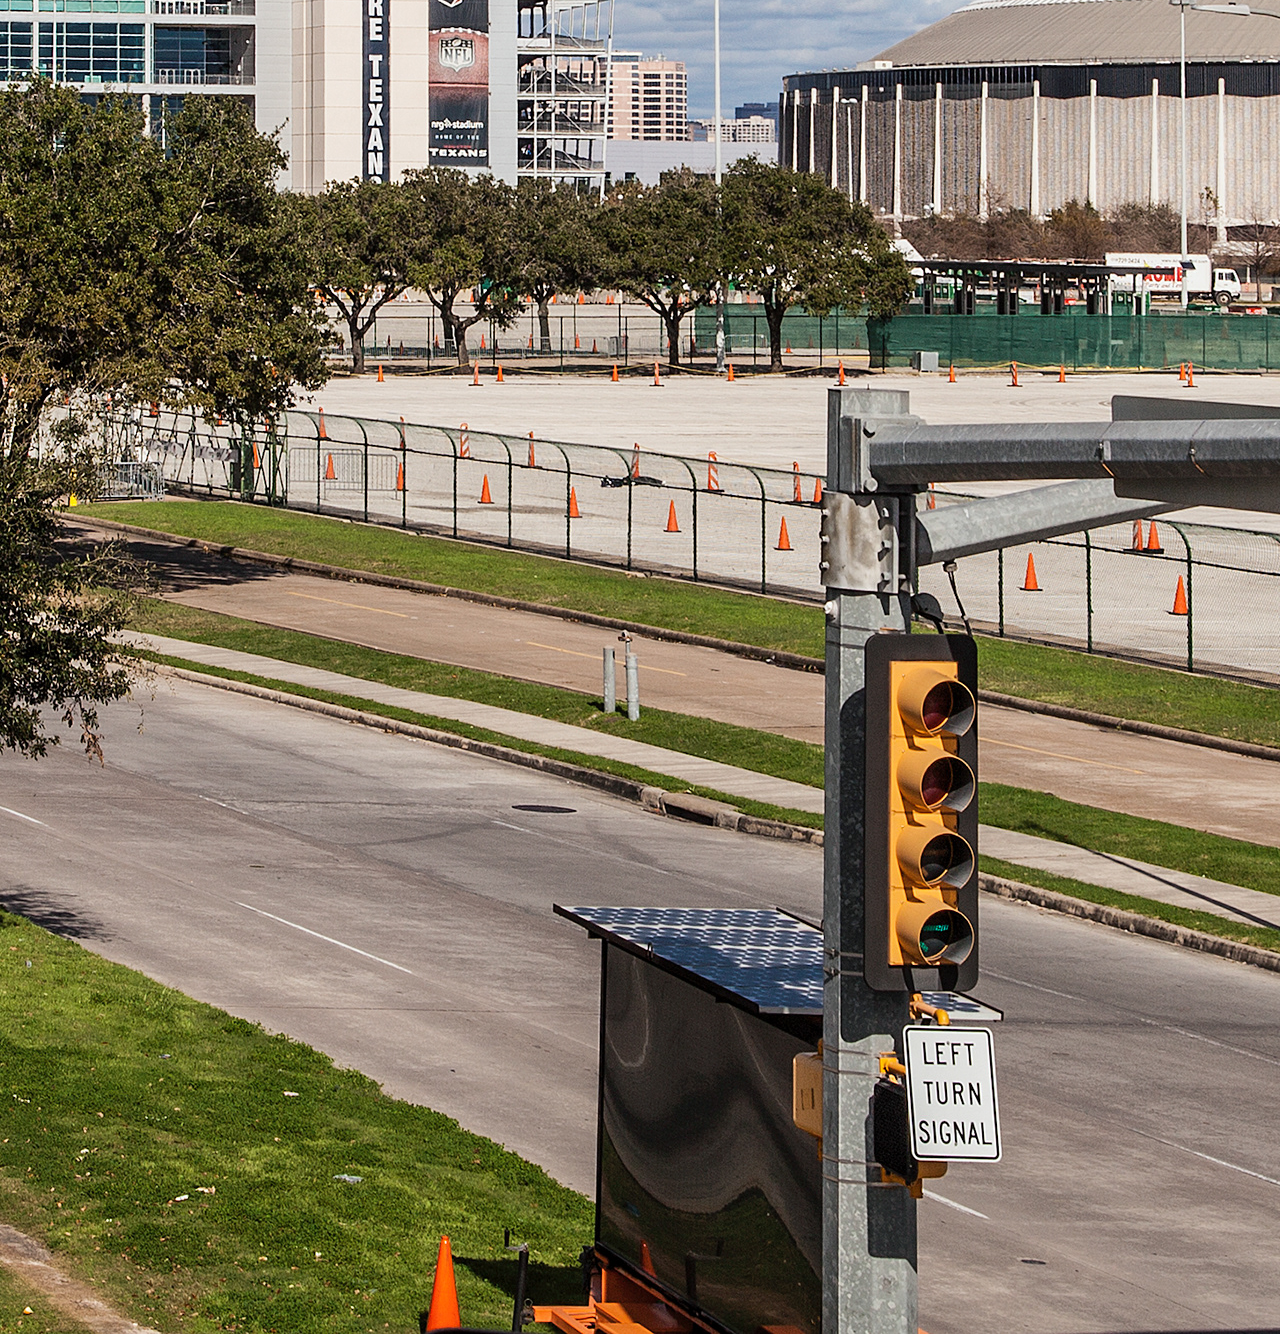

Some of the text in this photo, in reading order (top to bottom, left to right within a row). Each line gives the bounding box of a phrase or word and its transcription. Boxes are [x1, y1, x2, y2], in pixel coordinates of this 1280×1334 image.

[443, 48, 471, 65] NFL
[431, 119, 484, 131] nrg stadium
[428, 147, 487, 157] TEXANS
[922, 1041, 974, 1066] LEFT
[923, 1081, 981, 1105] TURN
[919, 1120, 993, 1145] SIGNAL
